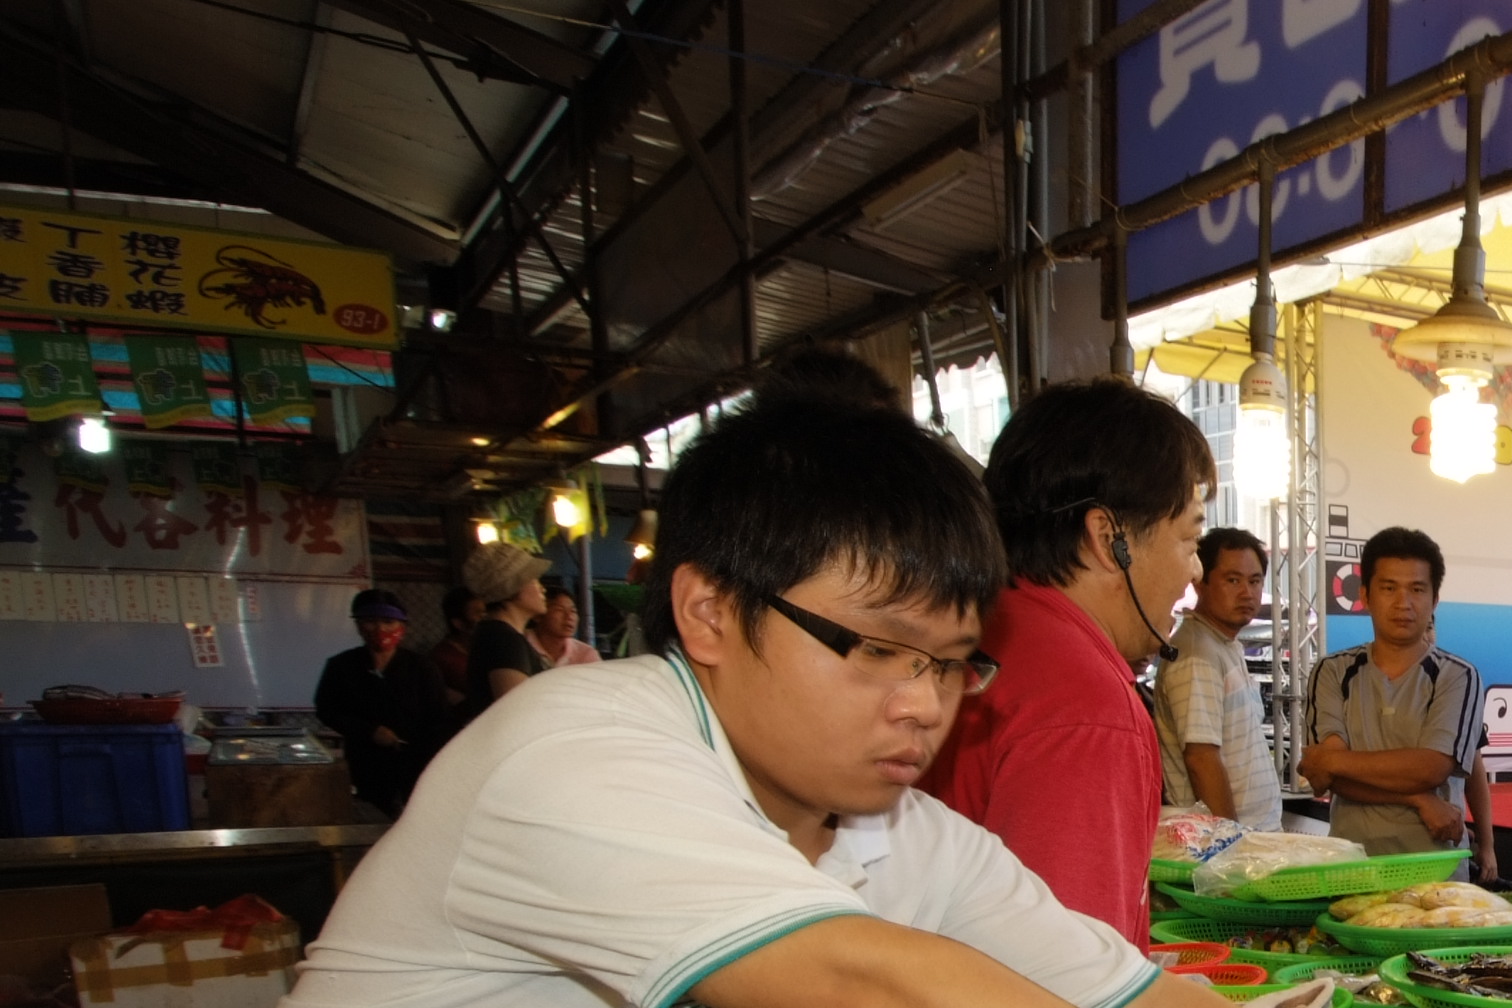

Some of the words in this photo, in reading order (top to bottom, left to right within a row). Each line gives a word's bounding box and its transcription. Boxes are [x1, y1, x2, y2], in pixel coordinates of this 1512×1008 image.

[120, 231, 190, 315] 櫻花蝦
[341, 309, 381, 330] 93-1
